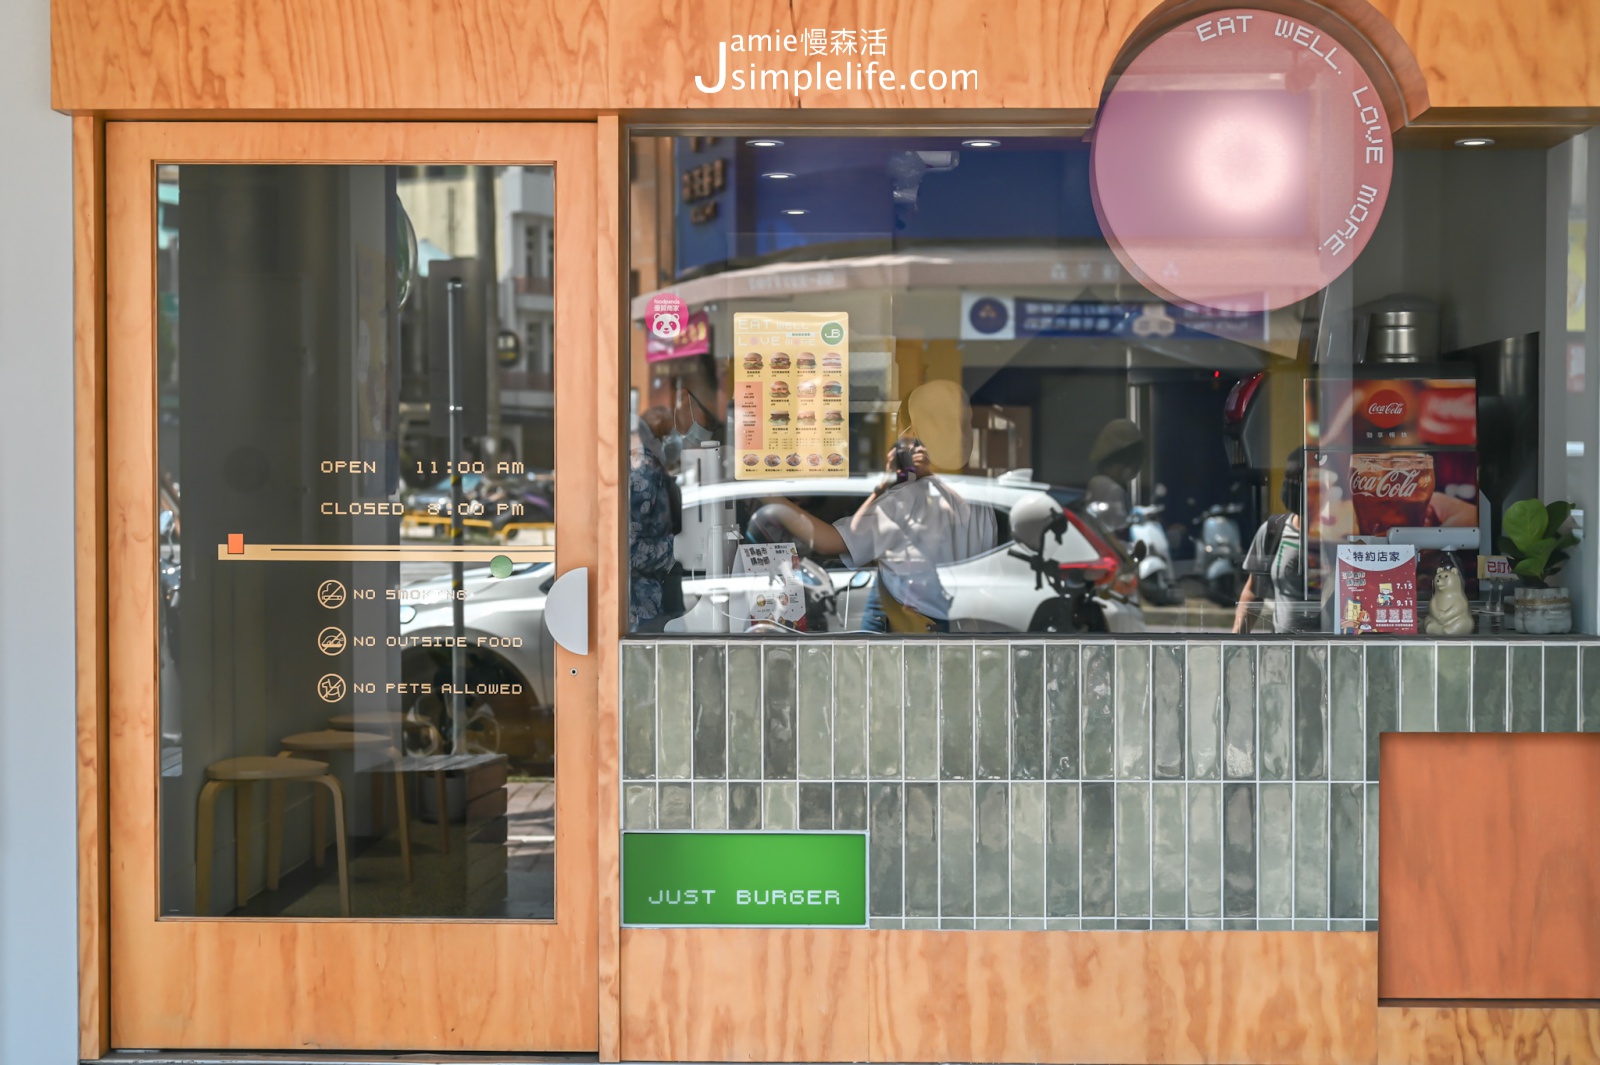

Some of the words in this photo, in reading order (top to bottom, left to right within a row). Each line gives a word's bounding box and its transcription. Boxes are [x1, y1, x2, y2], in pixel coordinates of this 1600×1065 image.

[1196, 15, 1253, 42] EAT
[1352, 86, 1384, 164] LOVE
[738, 319, 771, 330] EAT
[320, 461, 377, 474] OPEN
[416, 461, 485, 474] 11:00
[496, 461, 525, 474] AM
[320, 502, 405, 516] CLOSED
[427, 502, 485, 516] 8:00
[496, 502, 525, 516] PM
[1352, 551, 1400, 562] 特約店家
[353, 589, 376, 600] NO
[385, 588, 469, 600] SMOKNG
[353, 636, 376, 647] NO
[386, 636, 468, 647] OUTSIDE
[477, 636, 524, 648] FOOD
[353, 683, 376, 694] NO
[385, 683, 432, 694] PETS
[441, 683, 523, 695] ALLOWED
[648, 889, 716, 905] JUST
[736, 889, 840, 905] BURGER
